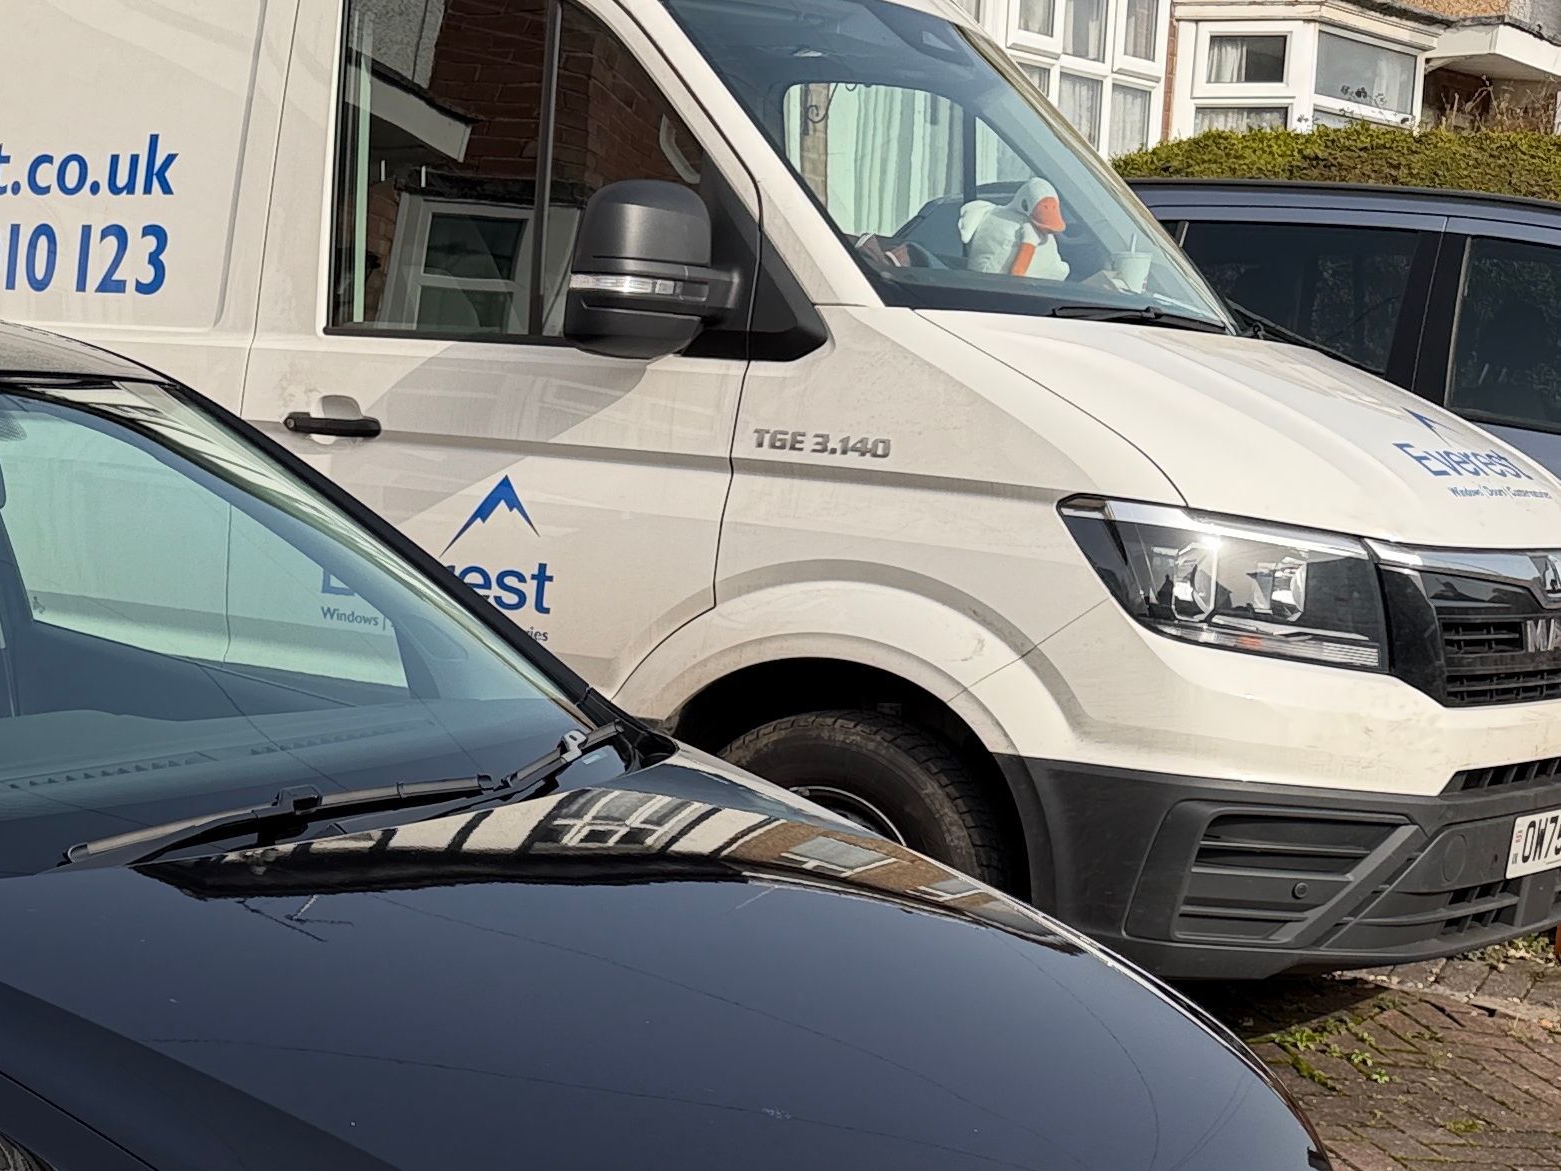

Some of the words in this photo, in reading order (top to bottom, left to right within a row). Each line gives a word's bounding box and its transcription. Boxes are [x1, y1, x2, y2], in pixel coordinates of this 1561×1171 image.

[75, 223, 169, 296] 123
[753, 428, 807, 451] TGE
[810, 433, 892, 459] 3.140
[1392, 442, 1534, 480] Everest
[320, 606, 379, 627] Windows
